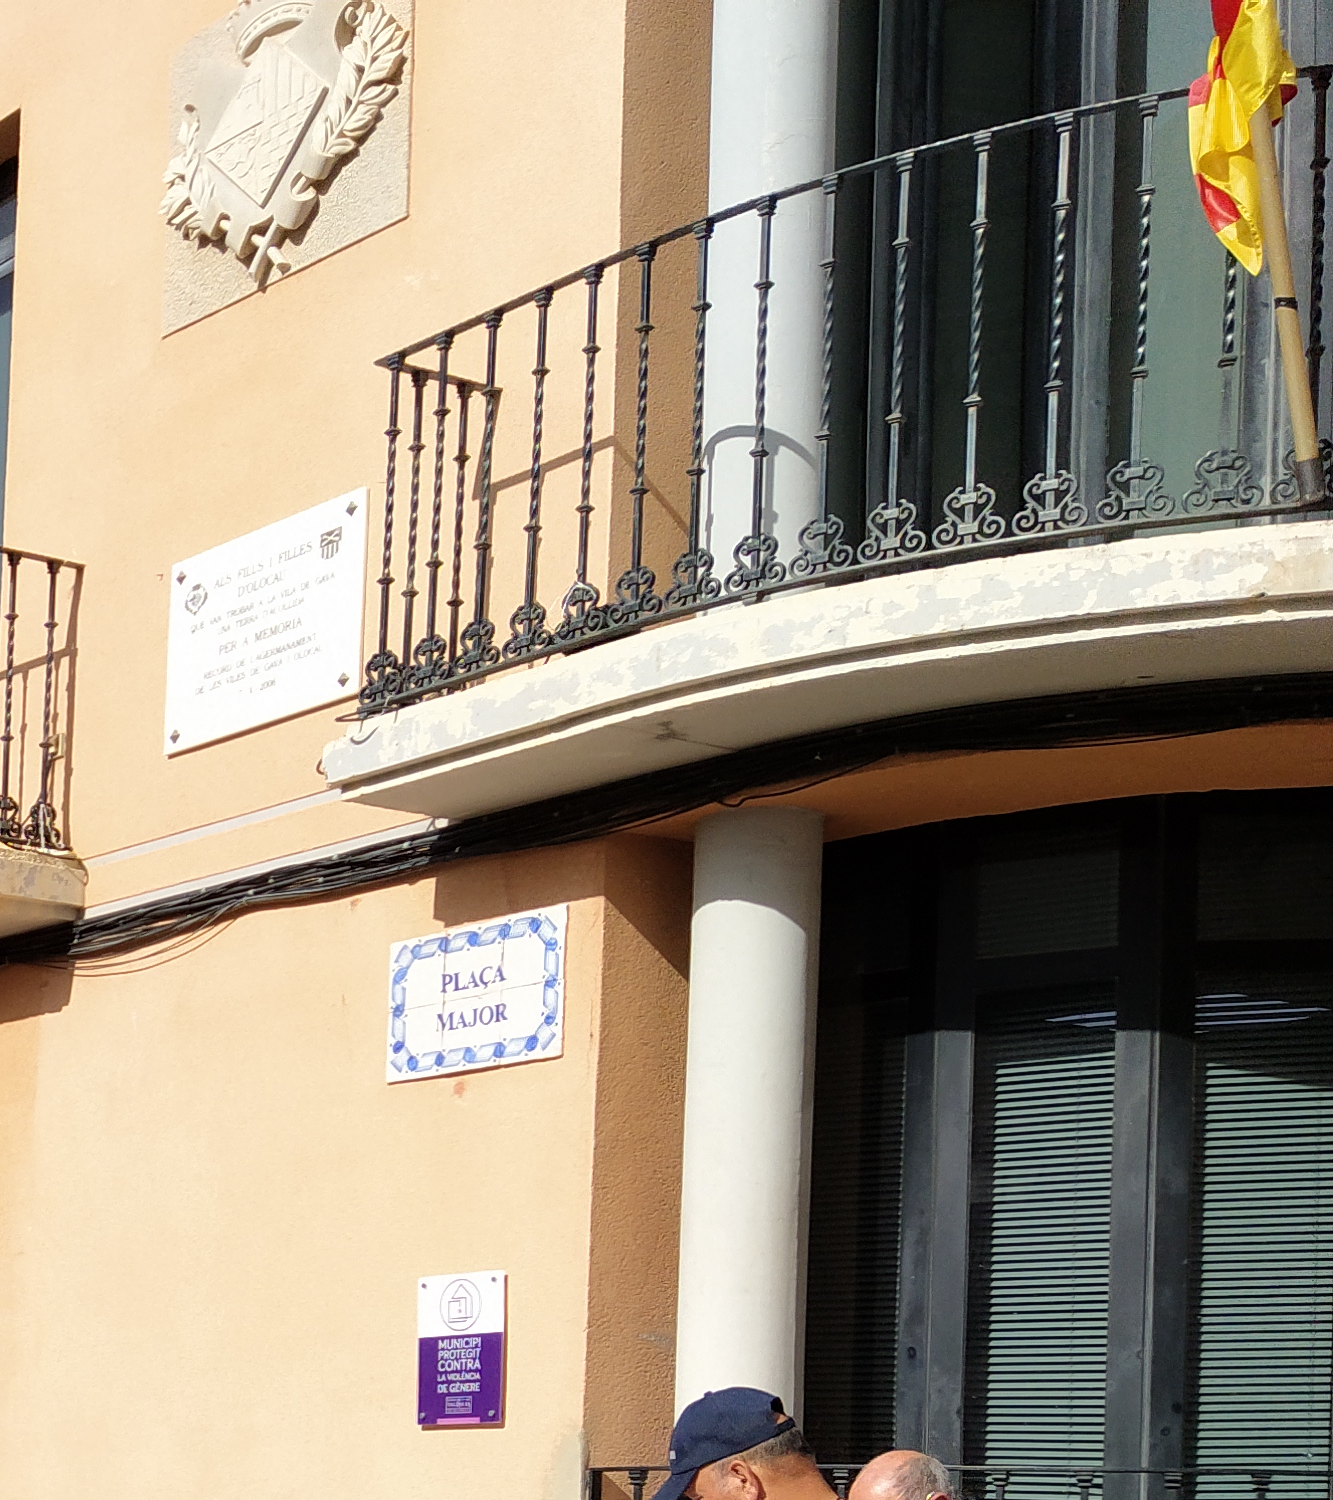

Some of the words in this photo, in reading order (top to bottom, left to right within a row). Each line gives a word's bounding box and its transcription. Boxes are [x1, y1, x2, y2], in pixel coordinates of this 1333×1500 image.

[238, 562, 263, 579] FILLS
[278, 542, 312, 563] FILLES
[219, 641, 236, 655] PER
[440, 965, 506, 993] PLAÇA
[436, 1003, 508, 1032] MAJOR
[438, 1337, 481, 1349] MUNICIPI
[438, 1348, 481, 1360] PROTEGIT
[438, 1359, 481, 1371] CONTRA
[437, 1373, 446, 1381] LA
[437, 1383, 448, 1393] DE
